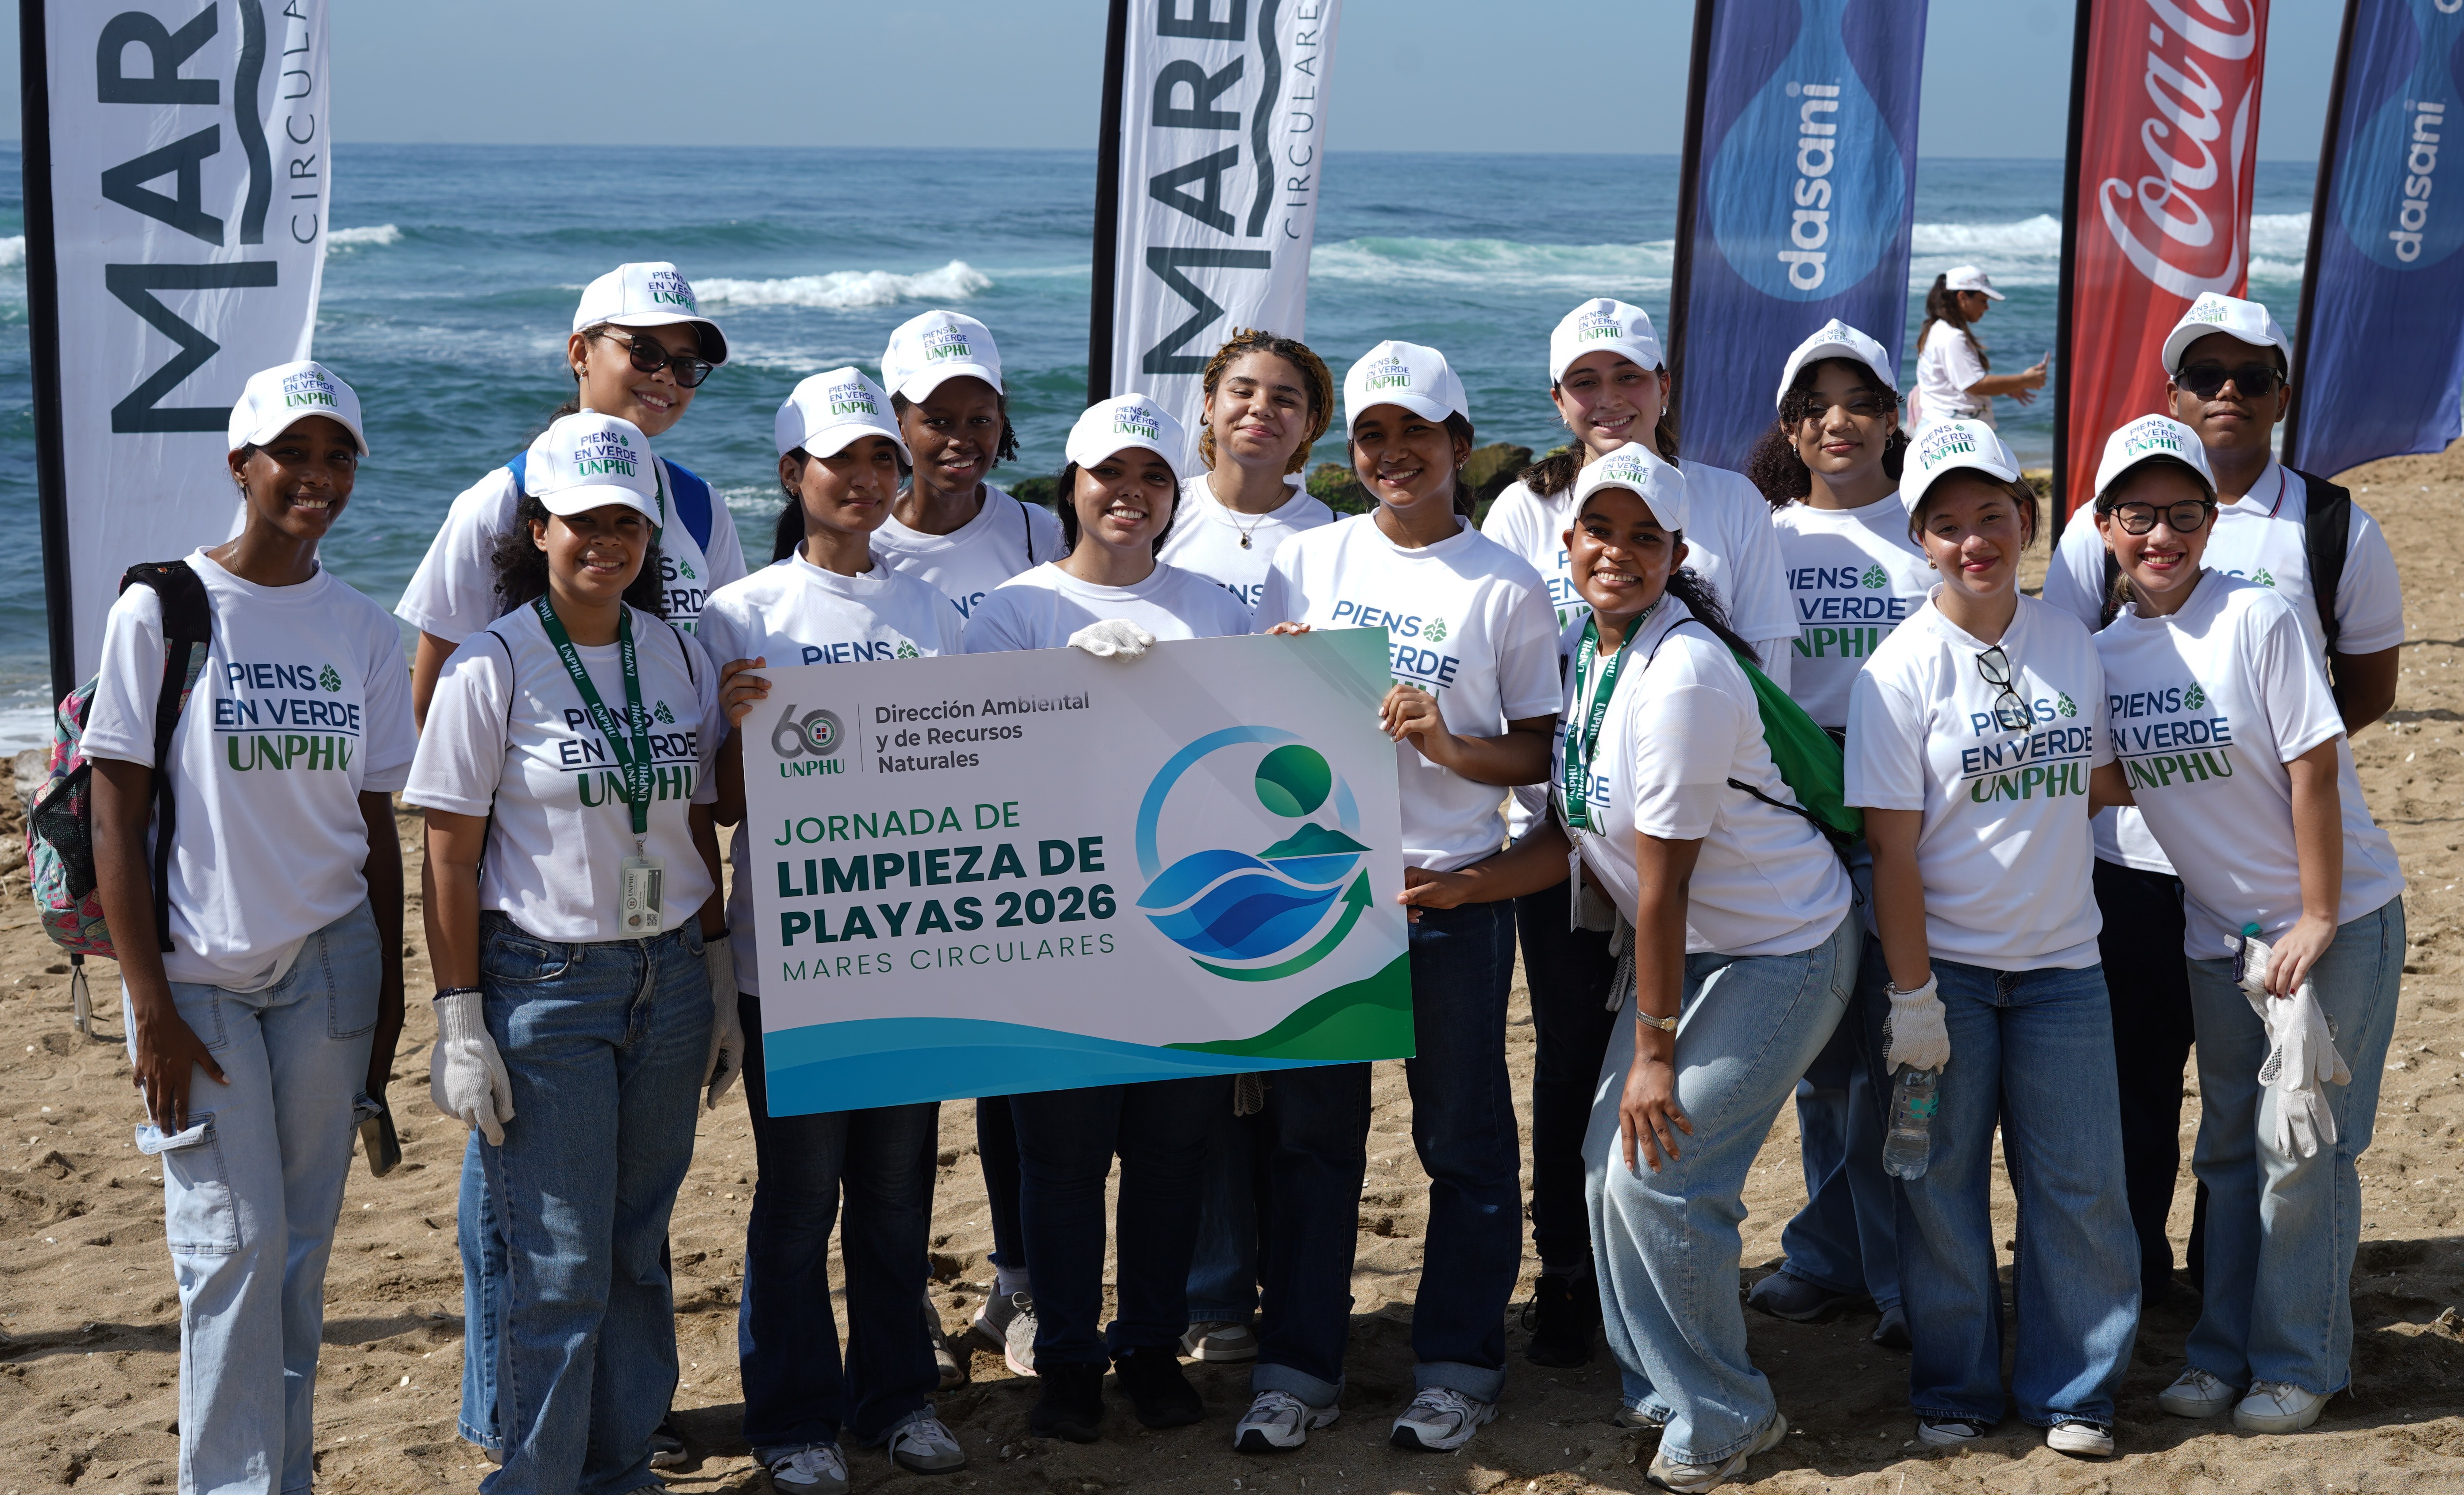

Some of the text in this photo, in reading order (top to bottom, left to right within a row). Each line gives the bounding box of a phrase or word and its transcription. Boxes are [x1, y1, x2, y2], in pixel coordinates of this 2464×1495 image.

[1777, 81, 1840, 290] dasani
[2389, 98, 2445, 263] dasani
[653, 272, 685, 285] PIENS
[654, 292, 698, 317] UNPHU
[2198, 306, 2227, 317] VERDE
[1579, 310, 1603, 324] PIENS
[1579, 318, 1622, 330] EN VERDE
[923, 326, 949, 341] PIENS
[924, 334, 968, 348] EN VERDE
[1578, 327, 1623, 343] UNPHU
[1827, 335, 1857, 344] VERDE
[926, 344, 972, 360] UNPHU
[1367, 357, 1390, 372] PIENS
[1378, 366, 1410, 374] VERDE
[283, 371, 315, 385] PIENS
[284, 380, 336, 393] EN VERDE
[828, 383, 857, 394] PIENS
[1365, 376, 1410, 392] UNPHU
[285, 393, 338, 407] UNPHU
[830, 391, 876, 402] EN VERDE
[831, 402, 879, 415] UNPHU
[1116, 406, 1142, 415] PIENS
[1113, 423, 1159, 440] UNPHU
[1131, 415, 1160, 427] VERDE
[2130, 420, 2165, 436] PIENS
[580, 432, 618, 445] PIENS
[1919, 433, 1974, 463] EN VERDE
[1920, 425, 1952, 449] PIENS
[2125, 428, 2184, 448] EN VERDE
[2128, 438, 2183, 457] UNPHU
[575, 445, 636, 462] EN VERDE
[1605, 455, 1631, 465] PIENS
[1924, 442, 1975, 470] UNPHU
[579, 460, 636, 478] UNPHU
[1599, 470, 1647, 484] UNPHU
[1618, 462, 1649, 474] VERDE
[1786, 567, 1858, 590] IENS
[1331, 600, 1423, 638] PIENS
[1799, 597, 1907, 620] VERDE
[560, 643, 585, 679] UNPHU
[625, 640, 635, 677] UNPHU
[802, 641, 894, 666] PIENS
[1578, 636, 1594, 673] UNPHU
[227, 662, 317, 691] PIENS
[216, 698, 359, 730] EN VERDE
[876, 691, 1089, 724] Dirección Ambiental
[2110, 687, 2181, 719] PIENS
[592, 702, 618, 738] UNPHU
[630, 701, 644, 736] UNPHU
[1589, 702, 1606, 740] UNPHU
[1970, 698, 2056, 737] PIENS
[771, 703, 845, 759] 60
[876, 723, 1023, 753] y de Recursos
[2132, 717, 2232, 751] VERDE
[228, 735, 353, 771] UNPHU
[559, 738, 606, 765] EN
[1962, 726, 2092, 774] EN VERDE
[780, 759, 845, 778] UNPHU
[878, 751, 979, 774] Naturales
[578, 766, 697, 807] UNHU
[638, 762, 649, 801] UNPHU
[1970, 761, 2087, 803] UNPHU
[774, 801, 1020, 846] JORNADA DE
[777, 836, 1105, 899] LIMPIEZA DE
[780, 883, 1116, 947] PLAYAS 2026
[783, 933, 1115, 983] MARES CIRCULARES
